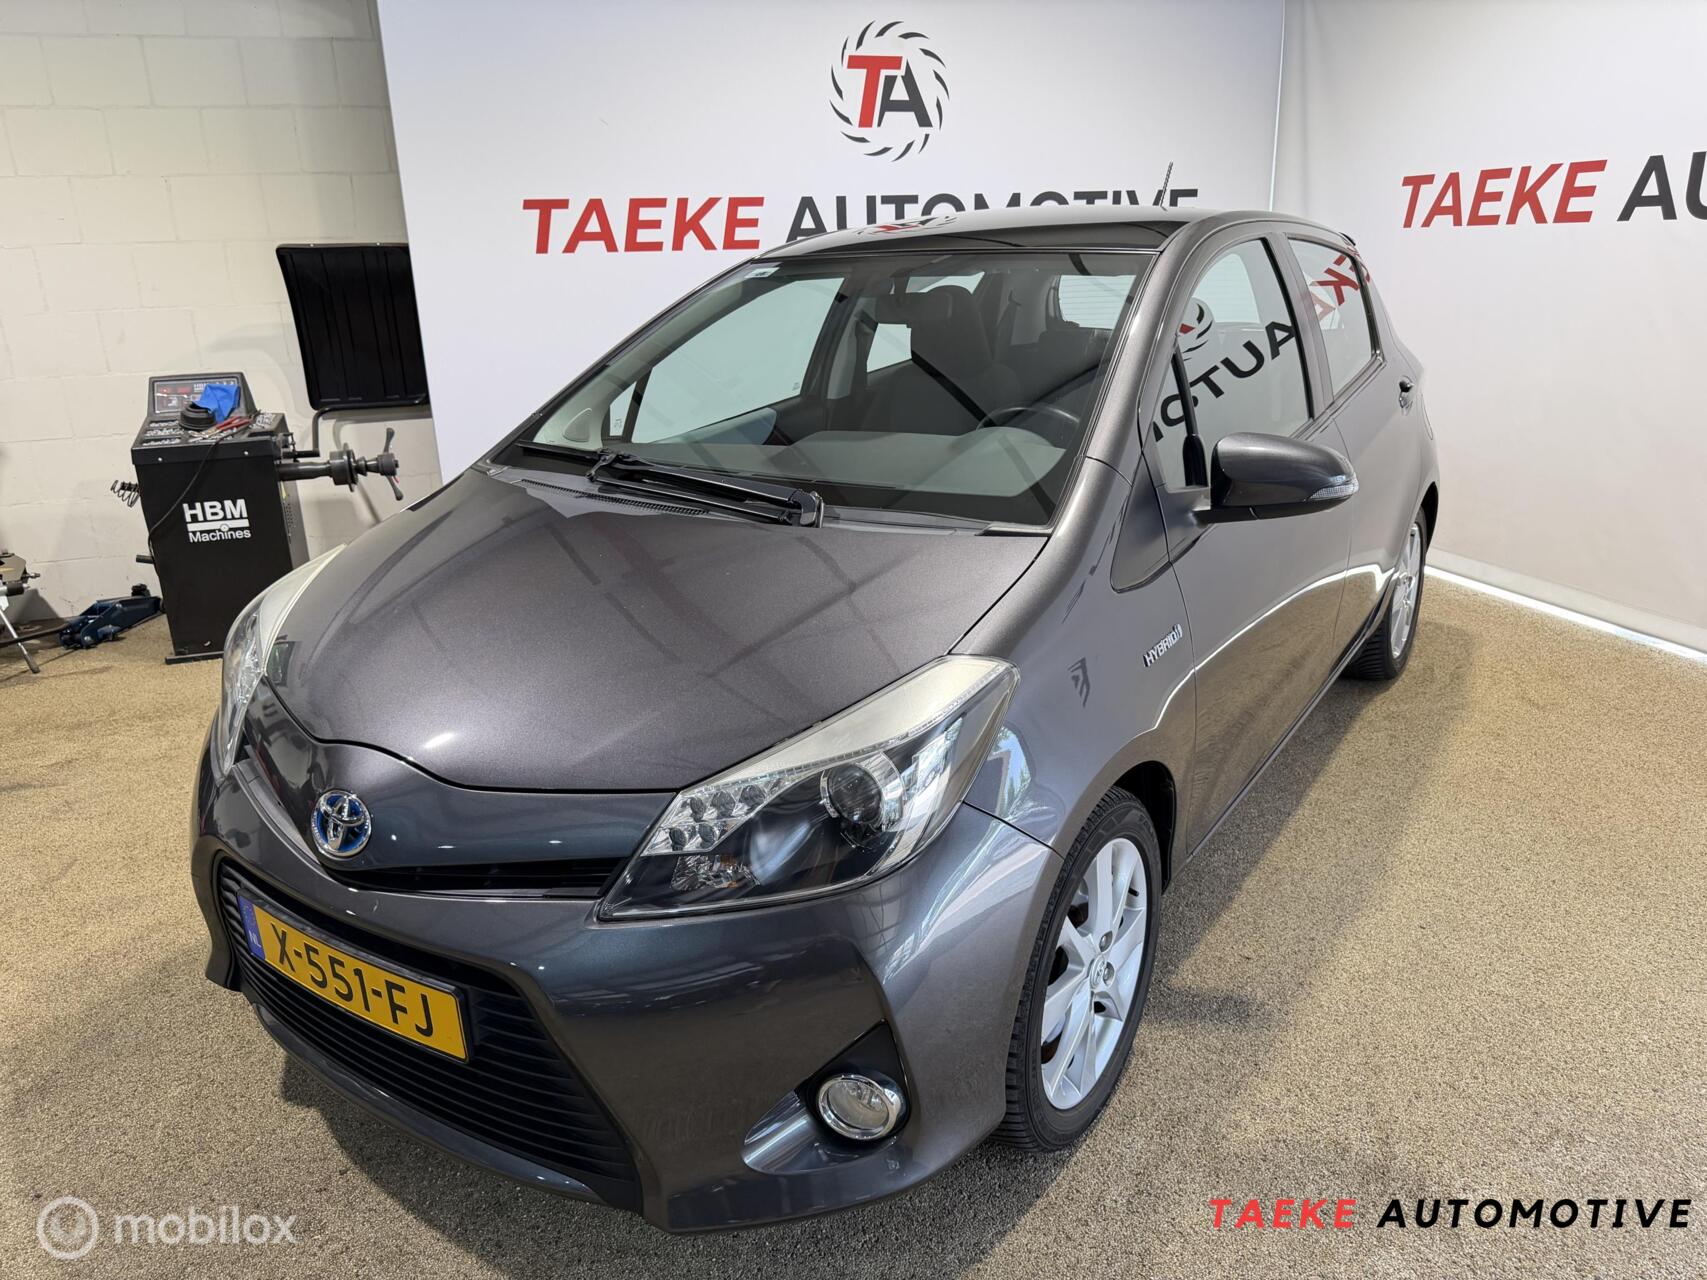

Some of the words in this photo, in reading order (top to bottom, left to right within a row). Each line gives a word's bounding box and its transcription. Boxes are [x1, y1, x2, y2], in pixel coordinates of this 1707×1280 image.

[846, 54, 934, 128] TA
[1401, 159, 1608, 229] TAEKE
[522, 196, 764, 254] TAEKE
[182, 498, 248, 523] HBM
[188, 529, 252, 543] Machines
[1142, 627, 1181, 668] HYBRID
[248, 930, 262, 948] NL
[271, 922, 434, 1037] X-551-FJ
